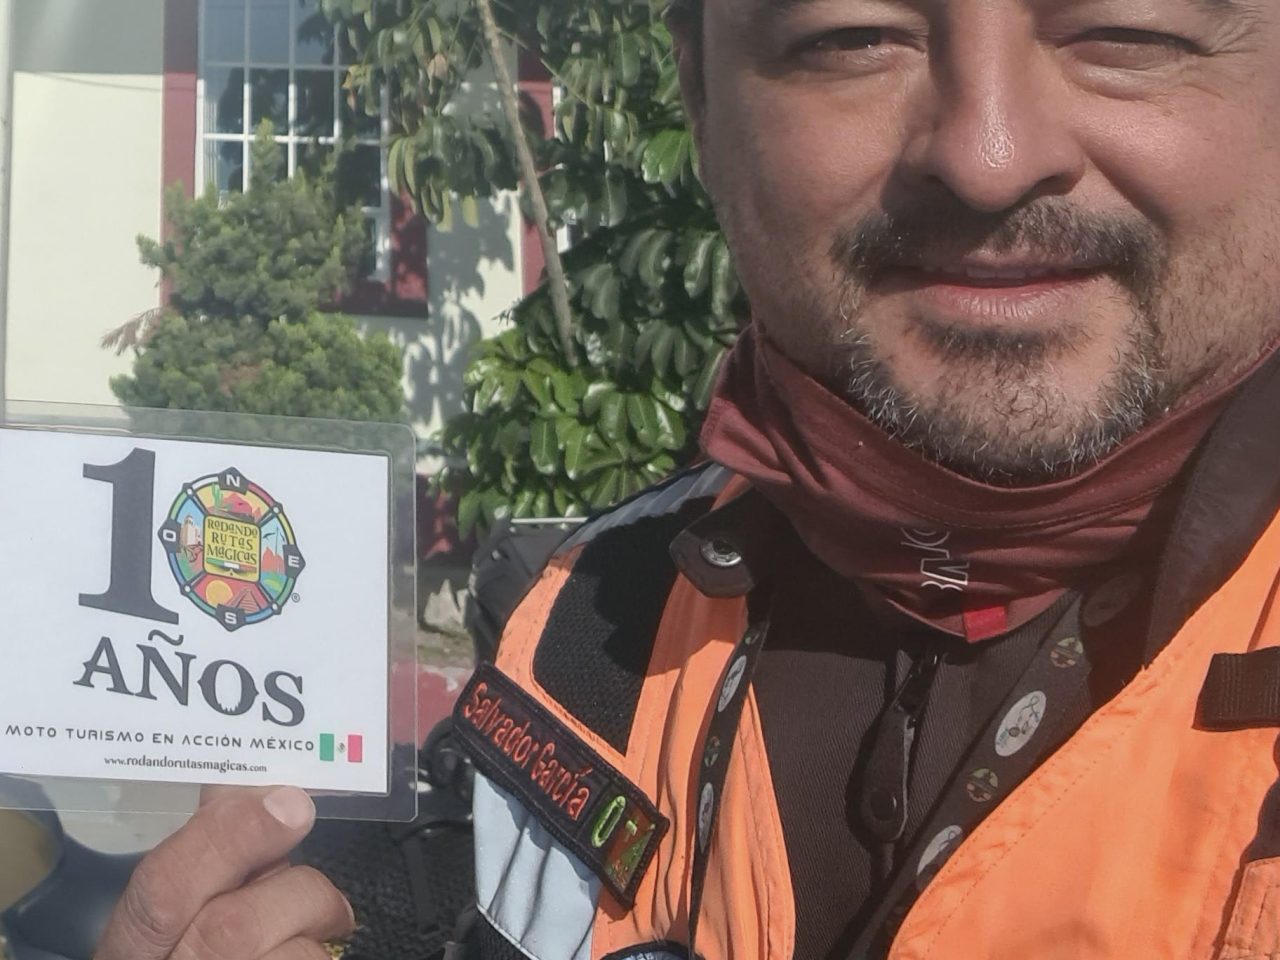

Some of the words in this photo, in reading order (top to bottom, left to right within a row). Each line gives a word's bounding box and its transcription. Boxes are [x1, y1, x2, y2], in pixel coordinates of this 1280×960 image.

[226, 474, 241, 488] N
[73, 629, 305, 727] AÑOS
[5, 724, 57, 738] MOTO
[65, 727, 145, 743] TURISMO
[152, 733, 174, 745] EN
[182, 734, 242, 748] ACCIÓN
[249, 736, 315, 752] MÉXICO
[464, 682, 539, 769] Salvador
[531, 742, 594, 821] García
[104, 754, 268, 773] www.rodandorutasmagicas.com
